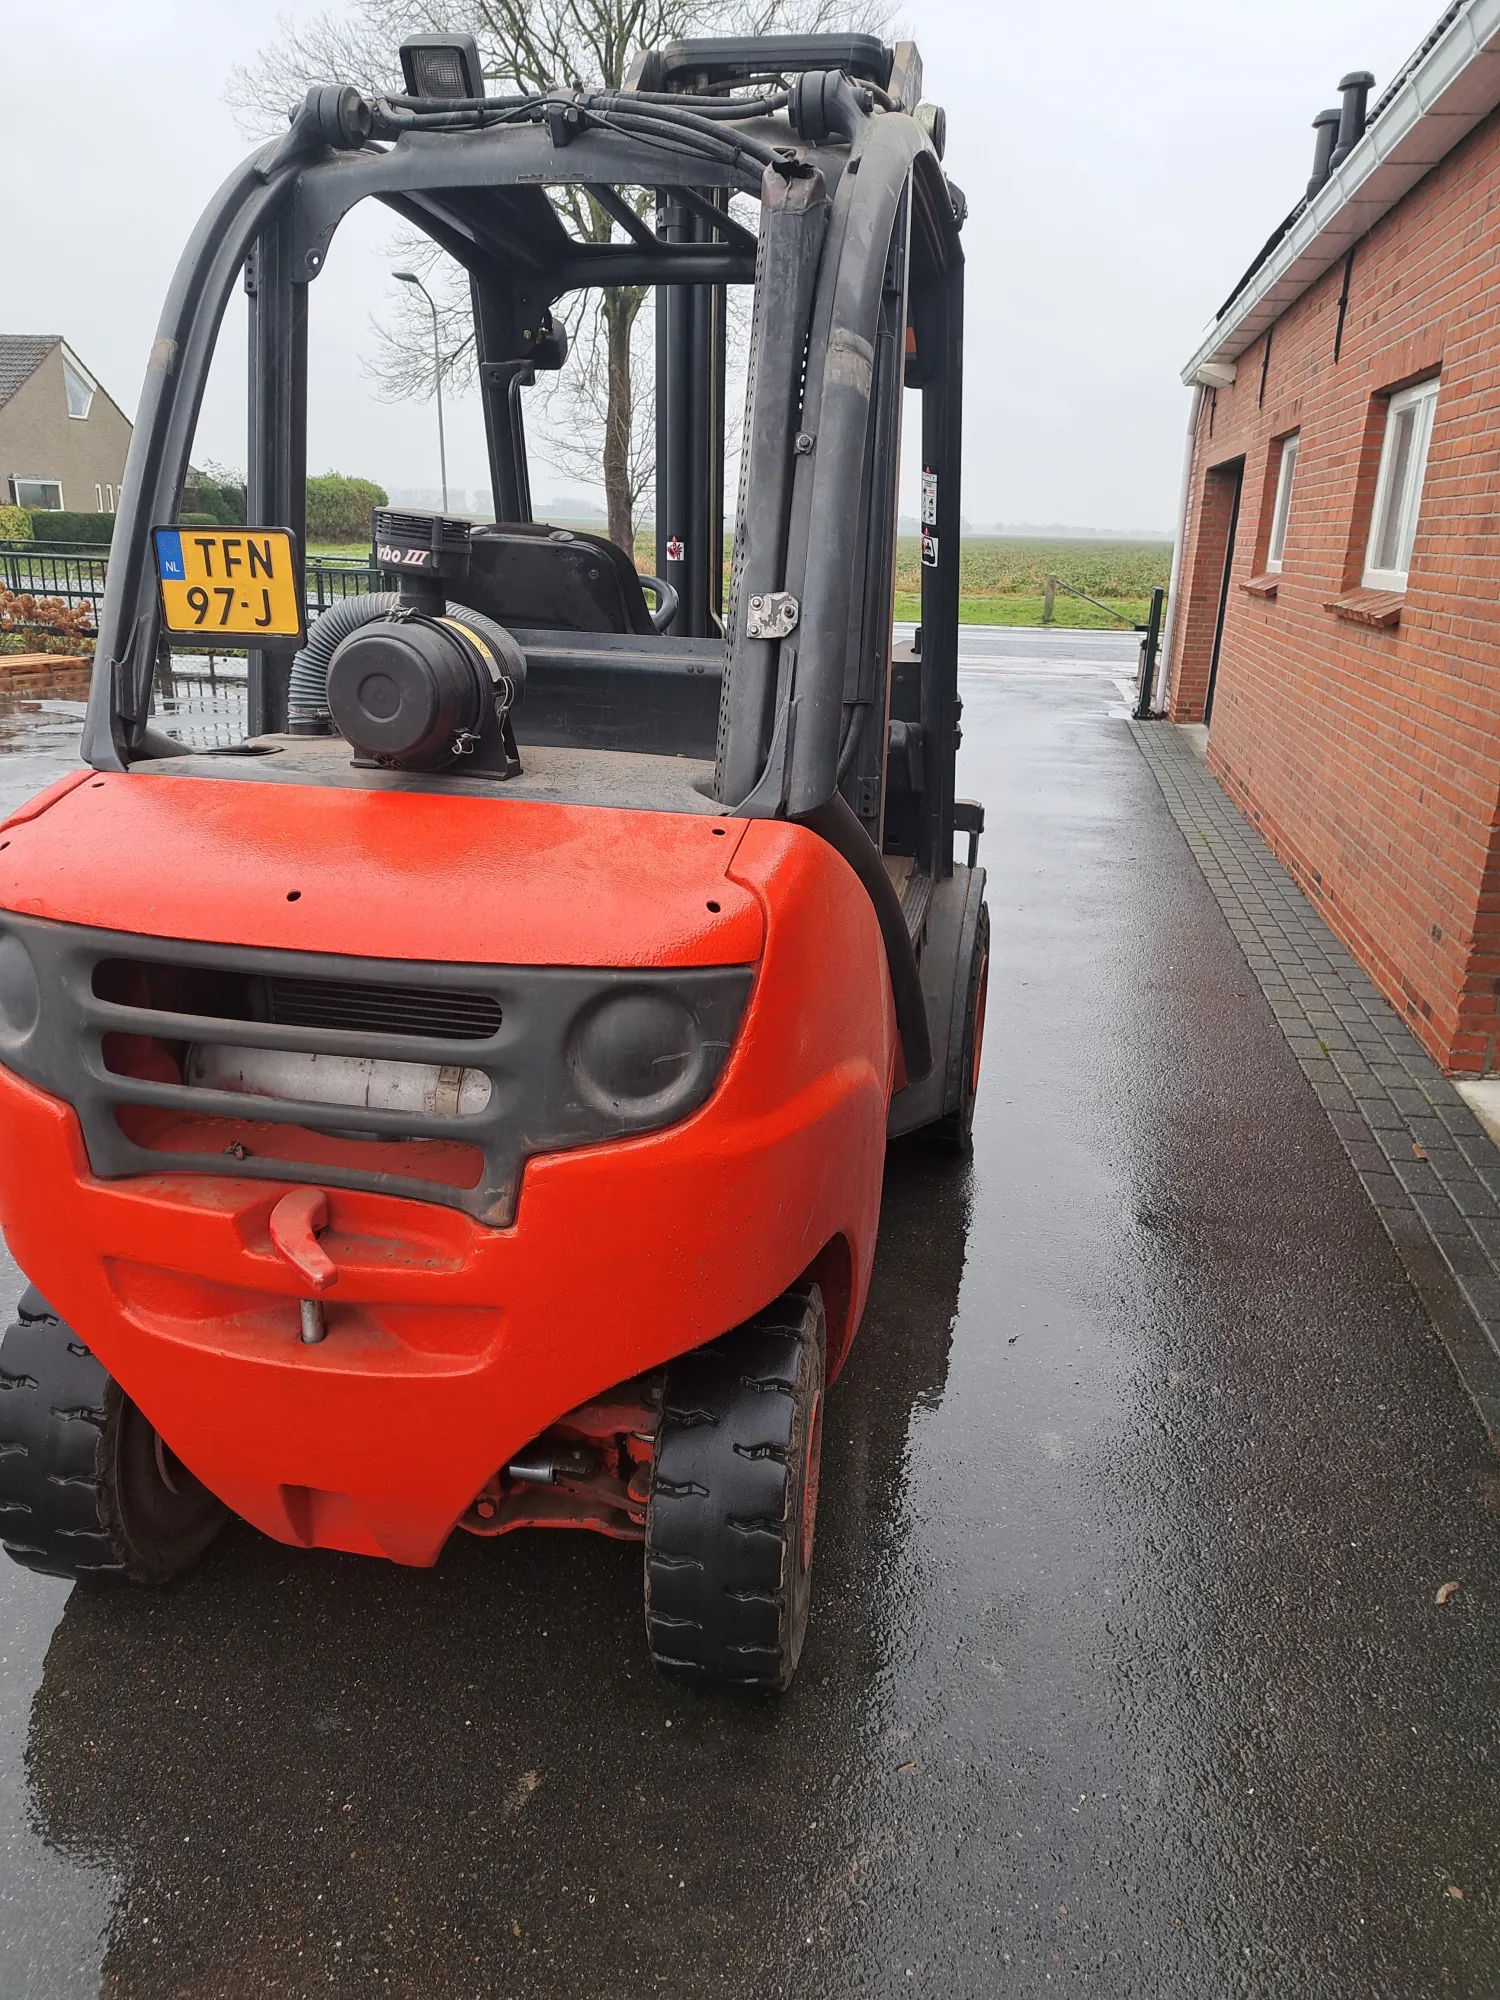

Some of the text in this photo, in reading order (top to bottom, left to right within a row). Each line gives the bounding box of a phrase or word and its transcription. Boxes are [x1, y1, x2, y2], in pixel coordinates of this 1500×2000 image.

[165, 561, 180, 573] NL
[194, 538, 275, 579] TFN
[377, 543, 430, 566] rbo III
[186, 586, 272, 627] 97-J
